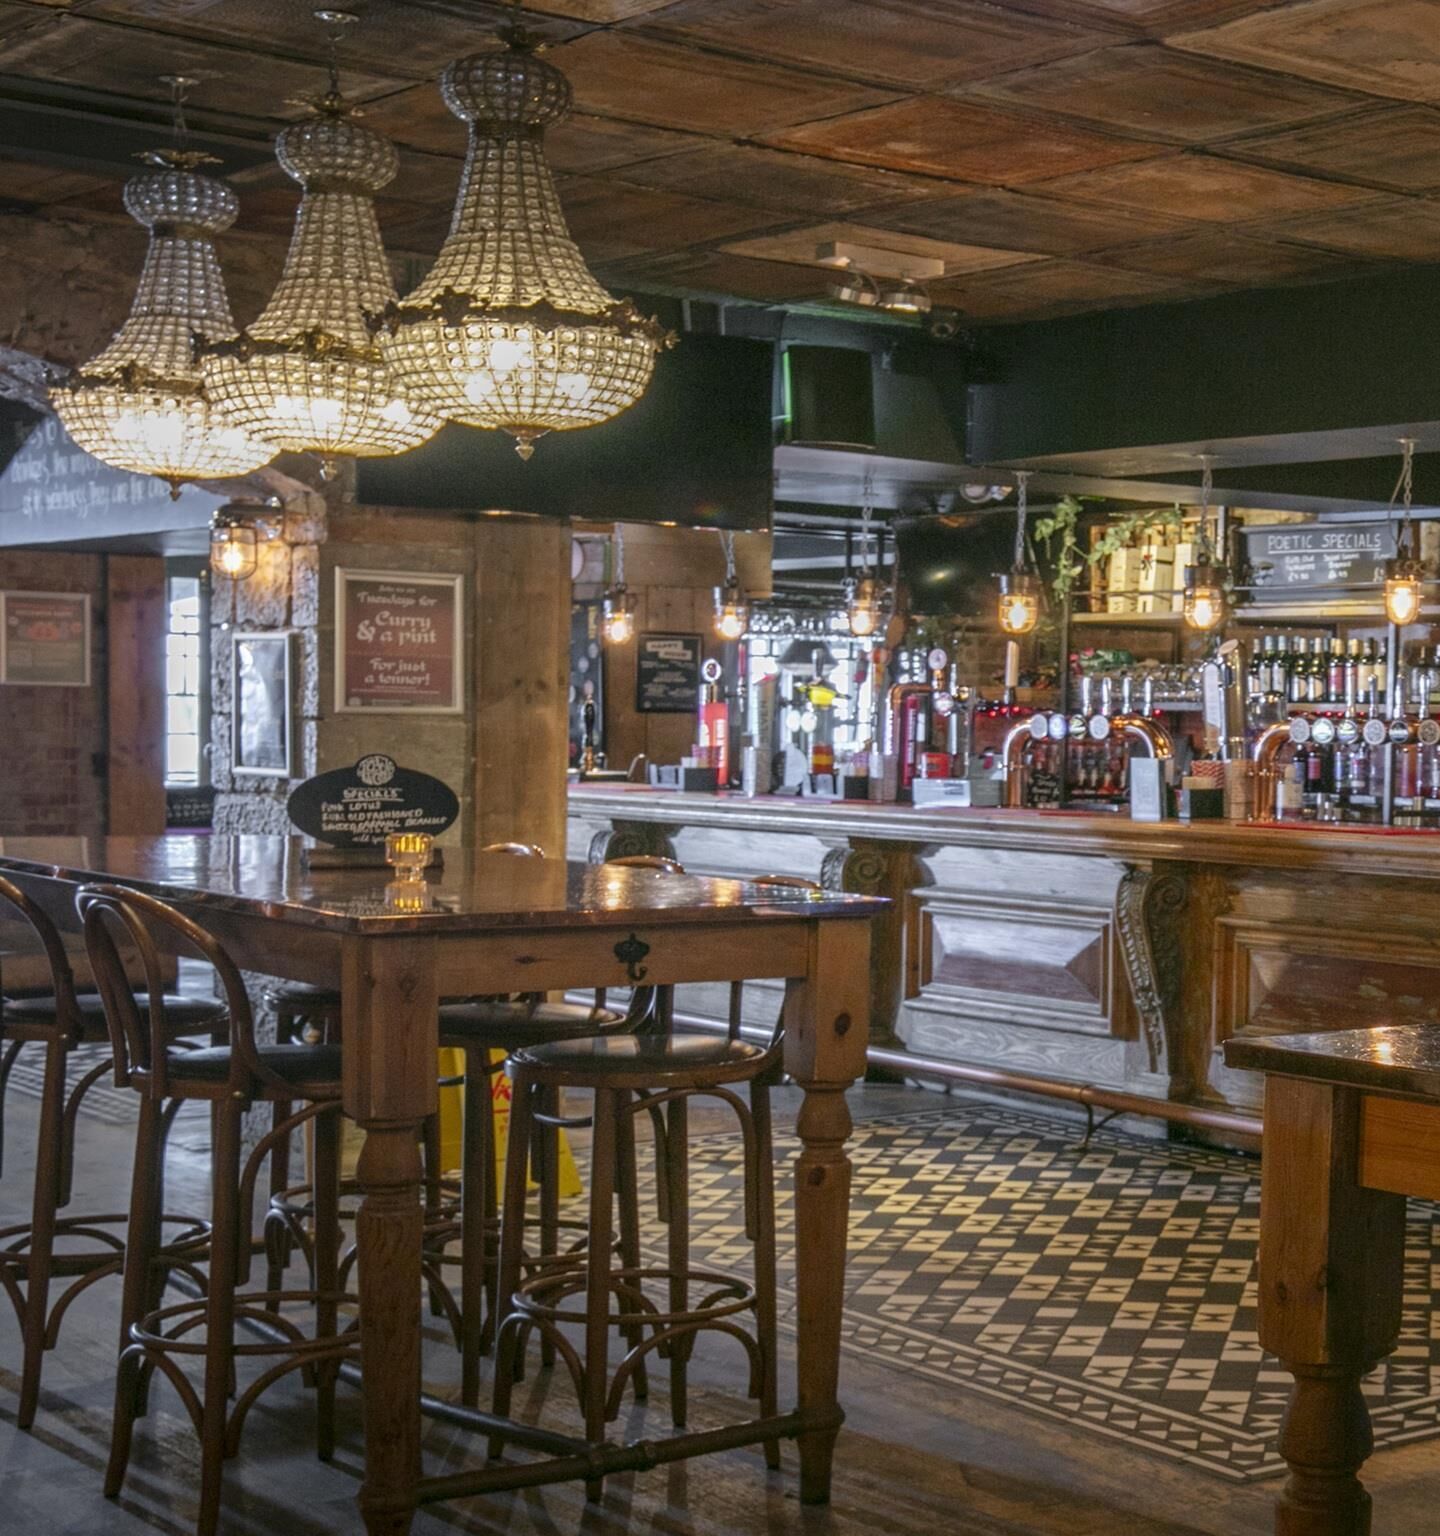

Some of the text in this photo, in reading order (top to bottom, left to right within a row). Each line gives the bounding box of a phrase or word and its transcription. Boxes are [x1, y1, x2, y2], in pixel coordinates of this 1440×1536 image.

[1268, 533, 1382, 550] POETIC SPECIALS
[375, 610, 431, 632] Curry
[356, 619, 437, 647] & a pint
[394, 660, 426, 675] just
[364, 673, 430, 686] a tenner!
